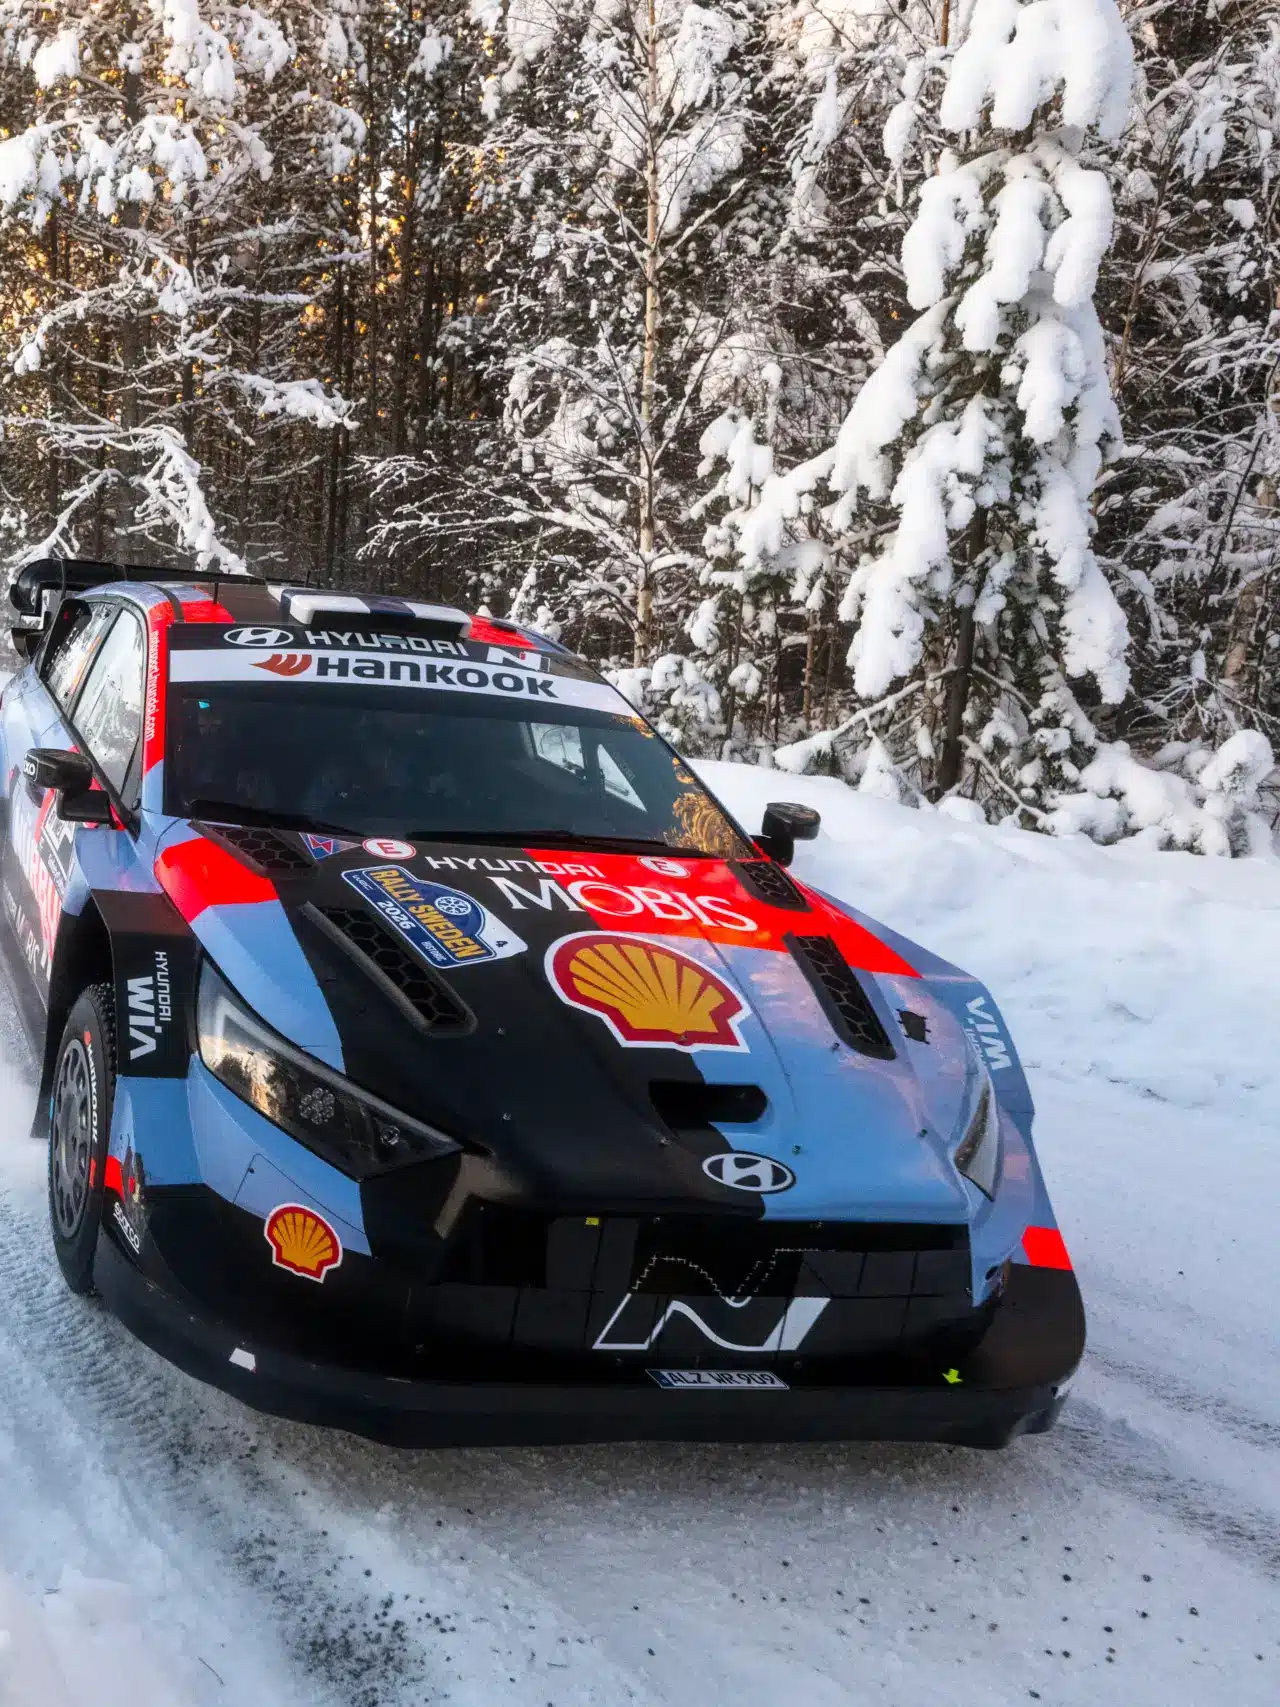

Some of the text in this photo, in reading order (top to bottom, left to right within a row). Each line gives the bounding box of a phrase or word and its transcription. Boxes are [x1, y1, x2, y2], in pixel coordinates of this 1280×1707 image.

[304, 630, 470, 656] HYUNDAI
[424, 856, 606, 878] HYUNDAI
[369, 869, 487, 958] RALLY SWEDEN
[376, 900, 416, 930] 2026
[485, 876, 758, 932] MOBIS
[155, 951, 172, 1022] HYUNDAI
[666, 1372, 711, 1385] ALZ
[707, 1372, 741, 1385] WR
